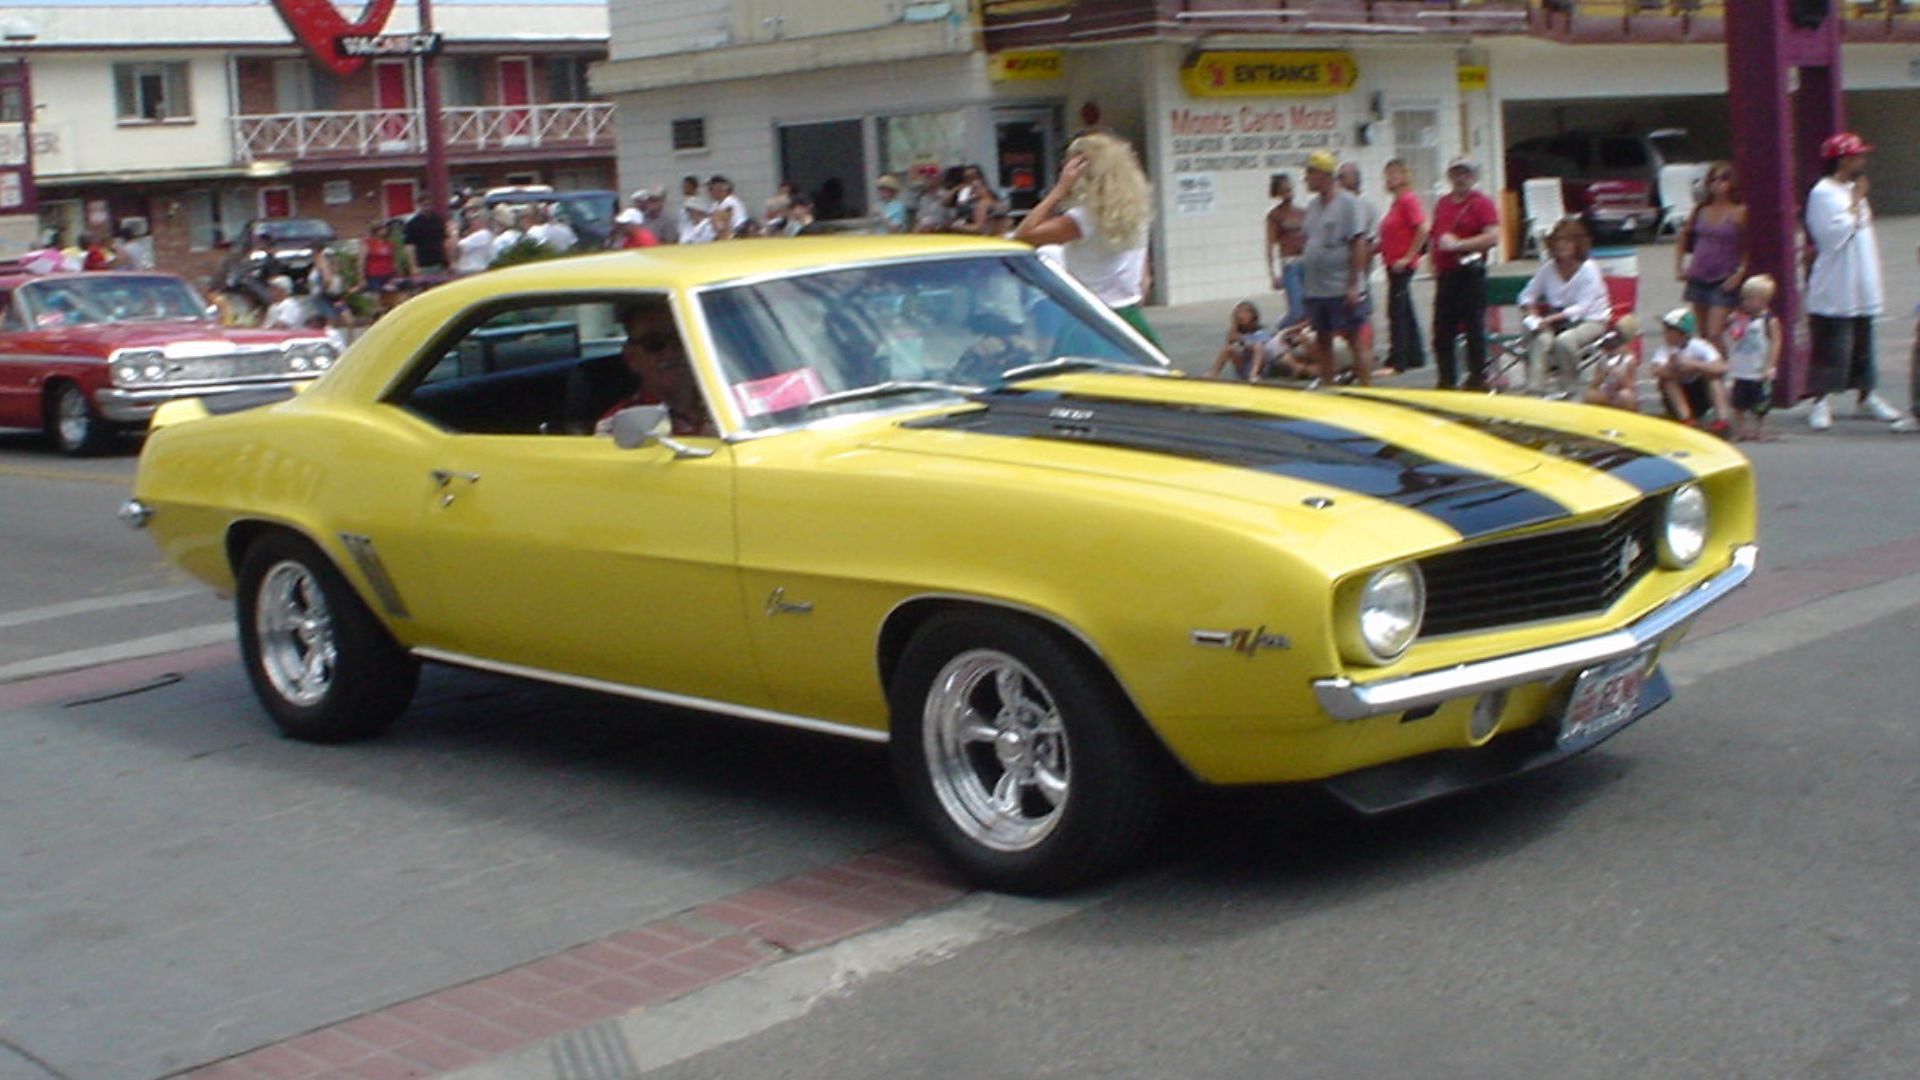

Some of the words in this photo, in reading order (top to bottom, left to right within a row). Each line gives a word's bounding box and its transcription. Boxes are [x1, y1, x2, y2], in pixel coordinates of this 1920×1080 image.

[341, 35, 437, 55] VACANCY
[1018, 56, 1058, 72] OFFICE
[1234, 63, 1320, 83] ENTRANCE
[1170, 108, 1233, 136] Monte
[1239, 104, 1286, 133] Carlo
[1290, 103, 1337, 130] Motel
